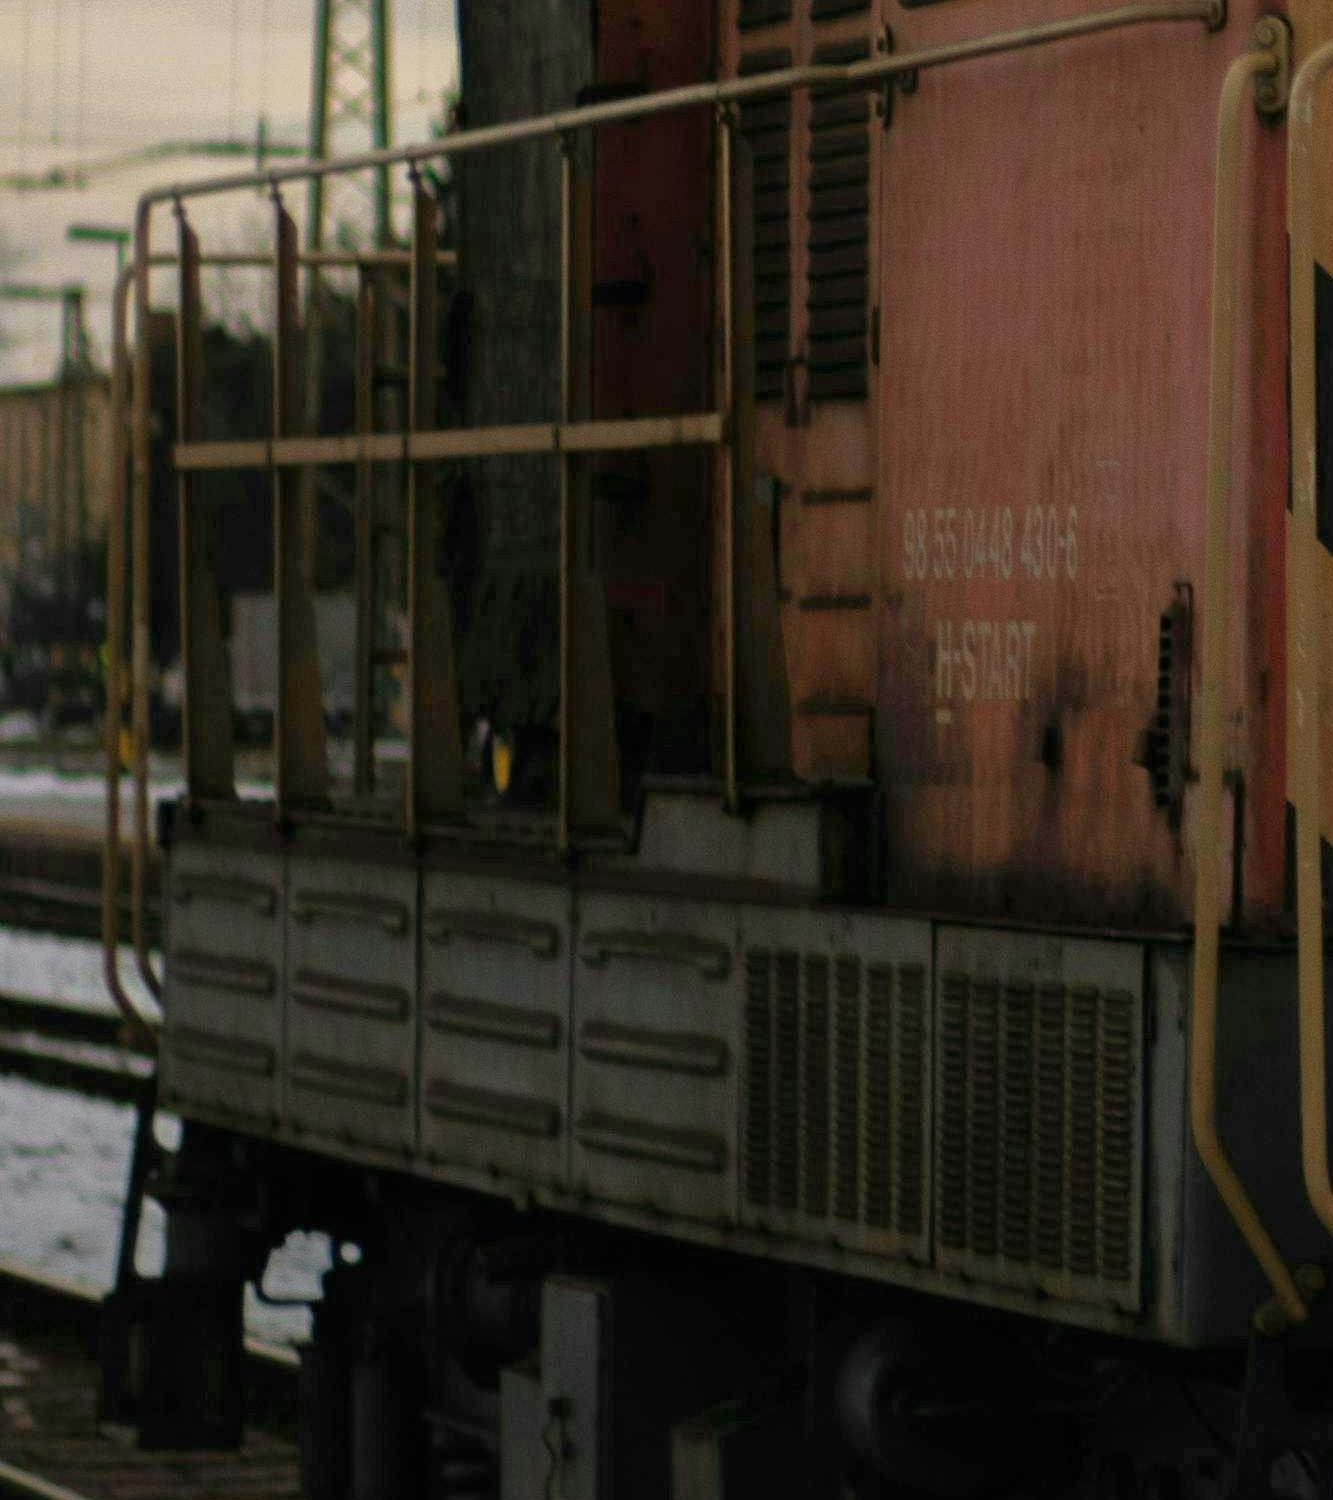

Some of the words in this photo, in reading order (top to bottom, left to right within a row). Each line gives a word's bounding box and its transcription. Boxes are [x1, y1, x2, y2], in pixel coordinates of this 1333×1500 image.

[904, 508, 928, 581] 98
[933, 506, 957, 579] 55
[962, 504, 1013, 580] 0448
[1020, 503, 1079, 580] 430-6
[936, 619, 1037, 701] H-START
